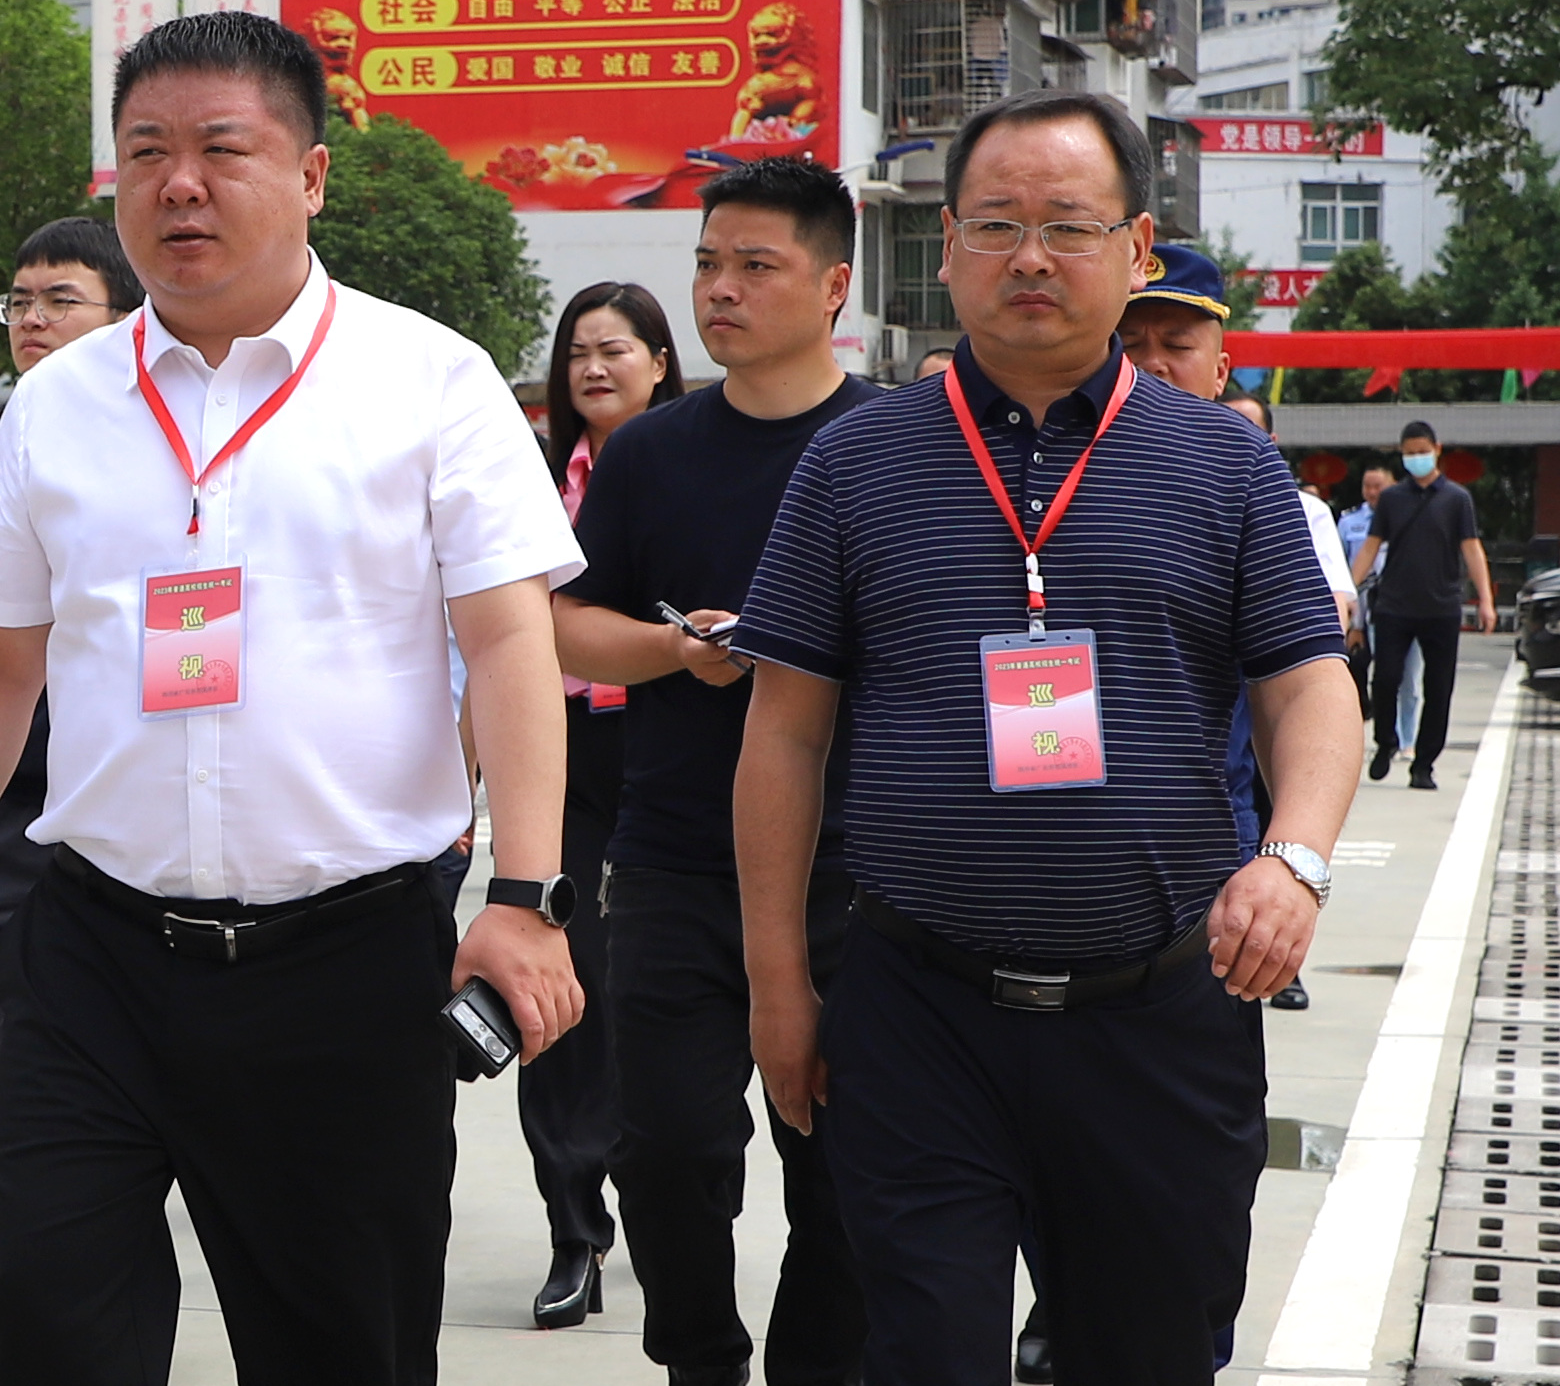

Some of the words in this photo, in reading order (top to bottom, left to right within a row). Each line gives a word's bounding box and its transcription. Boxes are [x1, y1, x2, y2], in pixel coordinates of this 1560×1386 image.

[377, 55, 437, 88] 公民
[465, 56, 515, 81] 爱国
[532, 54, 583, 79] 敬业
[601, 52, 652, 77] 诚信
[670, 50, 722, 76] 友善
[178, 606, 206, 680] 巡视
[1027, 683, 1061, 756] 巡视
